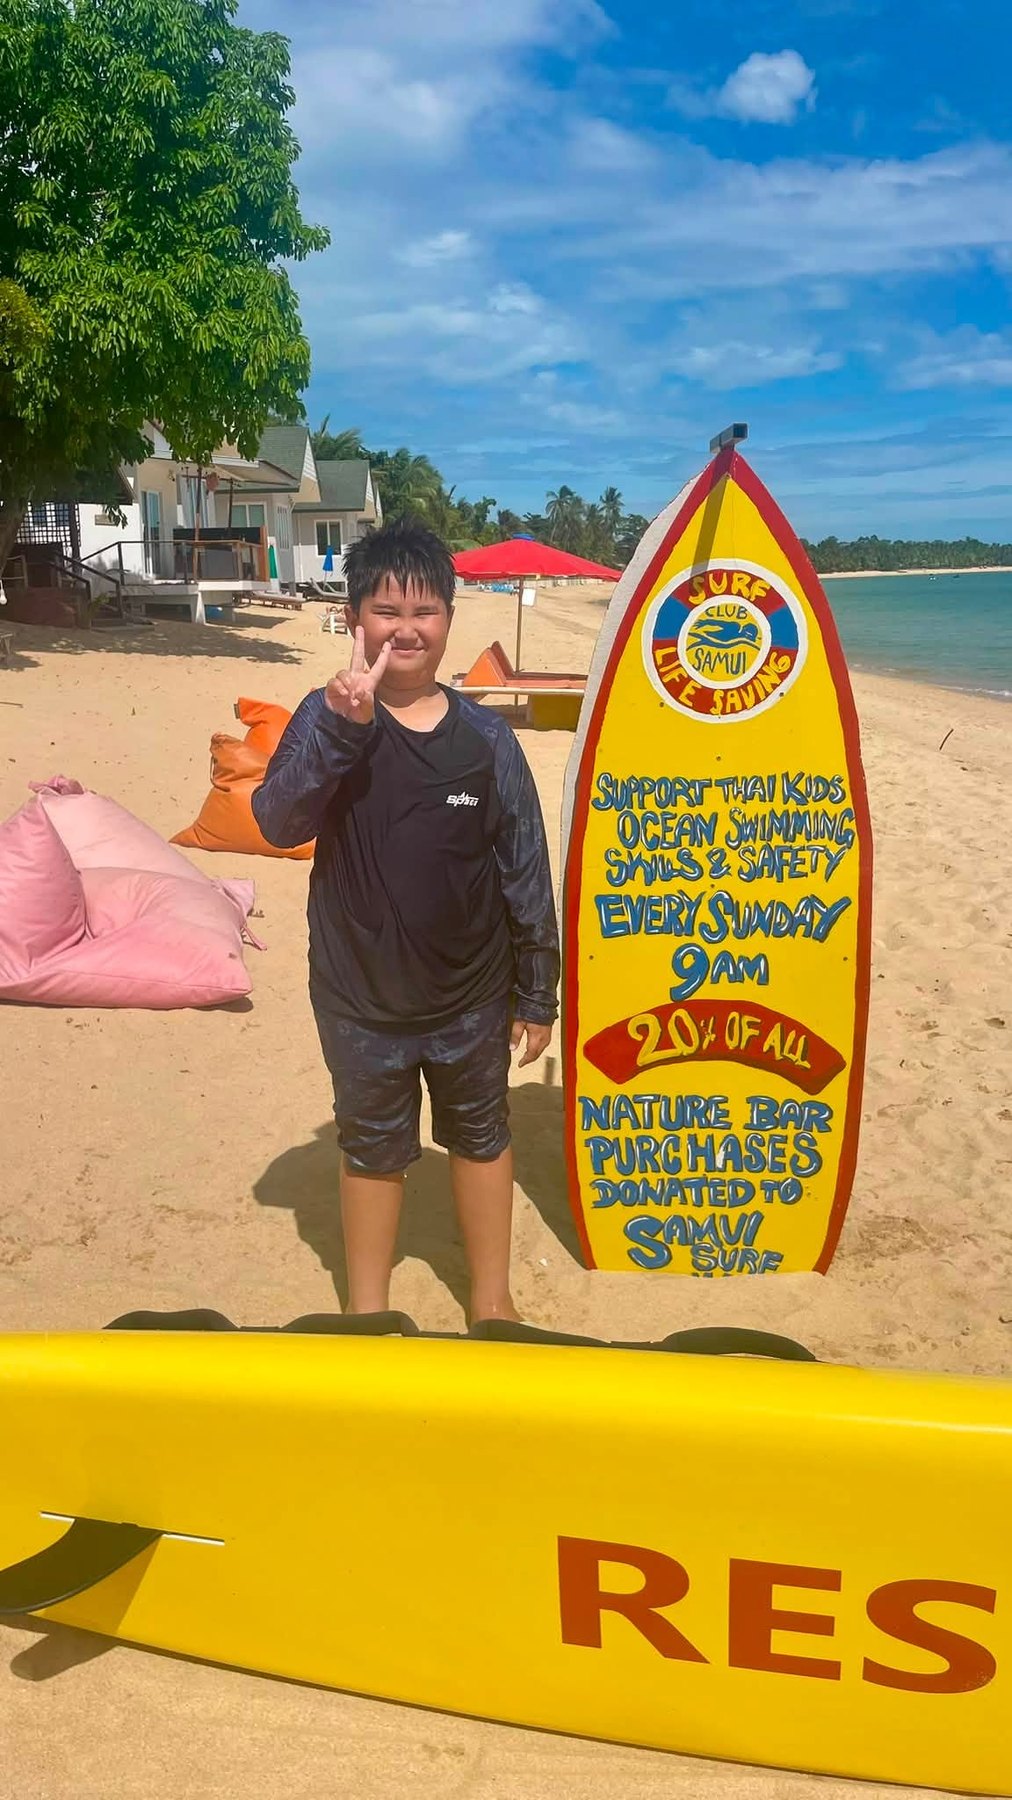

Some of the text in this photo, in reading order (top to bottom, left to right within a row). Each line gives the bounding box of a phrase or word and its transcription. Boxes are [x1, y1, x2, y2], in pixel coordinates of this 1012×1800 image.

[688, 572, 771, 605] SURF
[704, 604, 748, 620] CLUB
[655, 646, 791, 715] LIFE SAVING
[691, 647, 746, 675] SAMUI
[591, 771, 845, 811] SUPPORT THAI KIDS
[617, 807, 856, 850] OCEAN SWIMMING
[706, 848, 732, 879] &
[738, 842, 851, 883] SAFETY
[594, 889, 852, 944] EVERY SUNDAY
[725, 1011, 762, 1050] OF
[762, 1022, 812, 1069] ALL
[578, 1094, 834, 1133] NATURE BAR
[584, 1132, 823, 1178] PURCHASES
[590, 1176, 803, 1209] DONATED TO
[623, 1210, 765, 1270] SAMUI
[690, 1242, 784, 1274] SURF
[557, 1535, 997, 1694] RES
